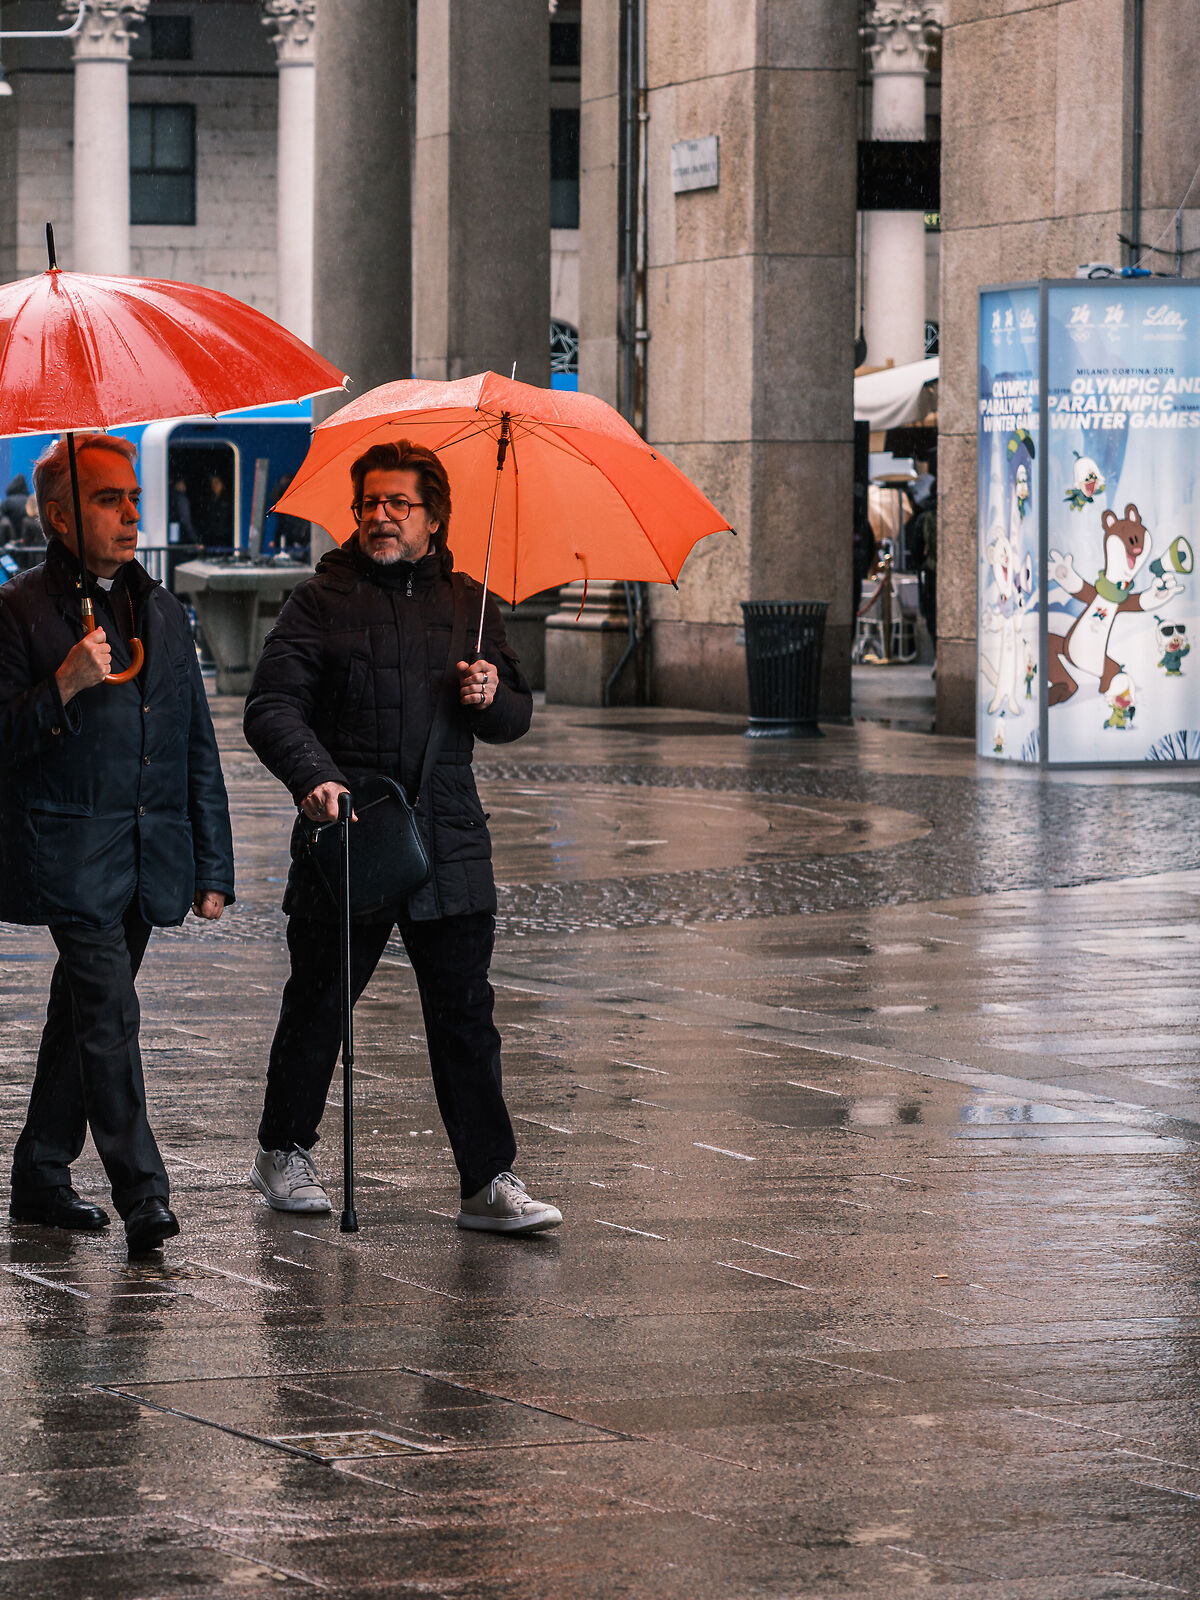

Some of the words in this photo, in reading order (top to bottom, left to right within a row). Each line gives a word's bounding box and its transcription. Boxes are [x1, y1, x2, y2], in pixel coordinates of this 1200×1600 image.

[1076, 368, 1109, 376] MILANO
[1112, 368, 1150, 376] CORTINA
[1071, 377, 1160, 395] OLYMPIC
[1047, 394, 1174, 413] PARALYMPIC
[1050, 412, 1125, 430] WINTER
[1129, 411, 1200, 430] GAMES
